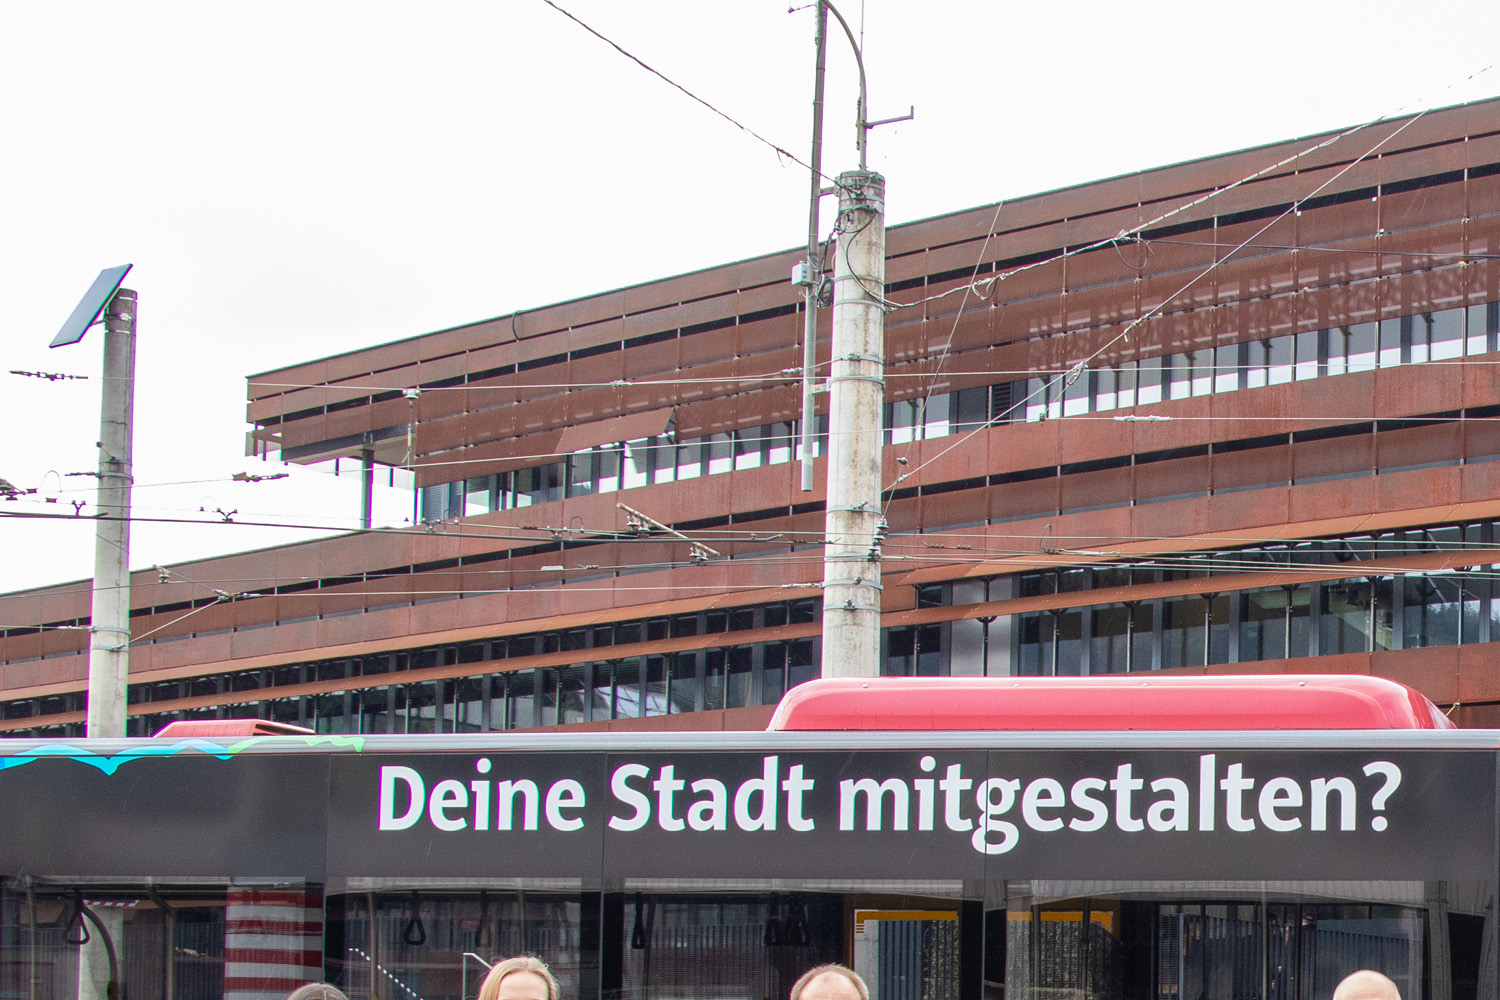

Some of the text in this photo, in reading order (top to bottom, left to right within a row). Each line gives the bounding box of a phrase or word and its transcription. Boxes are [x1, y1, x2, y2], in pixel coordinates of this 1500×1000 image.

[379, 753, 1403, 855] Deine Stadt mitgestalten?
